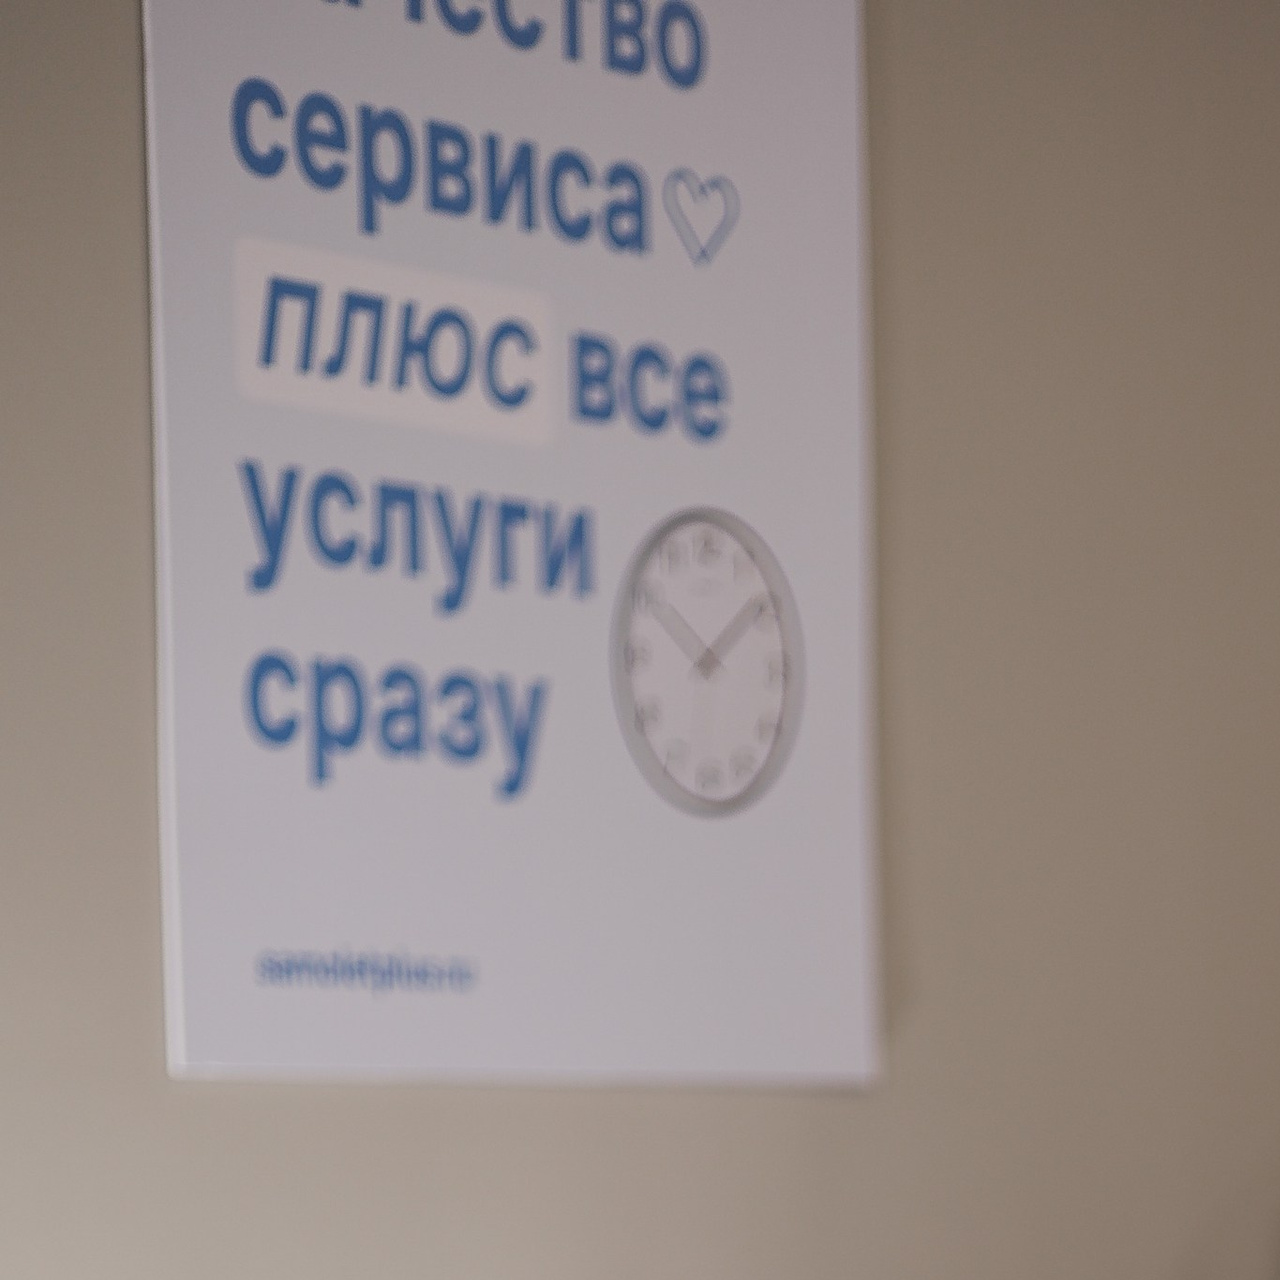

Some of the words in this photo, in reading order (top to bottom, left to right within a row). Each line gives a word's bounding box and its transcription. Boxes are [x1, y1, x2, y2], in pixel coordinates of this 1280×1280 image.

[320, 0, 712, 91] ство
[230, 76, 654, 257] сервиса
[257, 274, 539, 412] плюс
[570, 330, 730, 444] все
[237, 457, 596, 615] услуги
[244, 647, 552, 799] сразу
